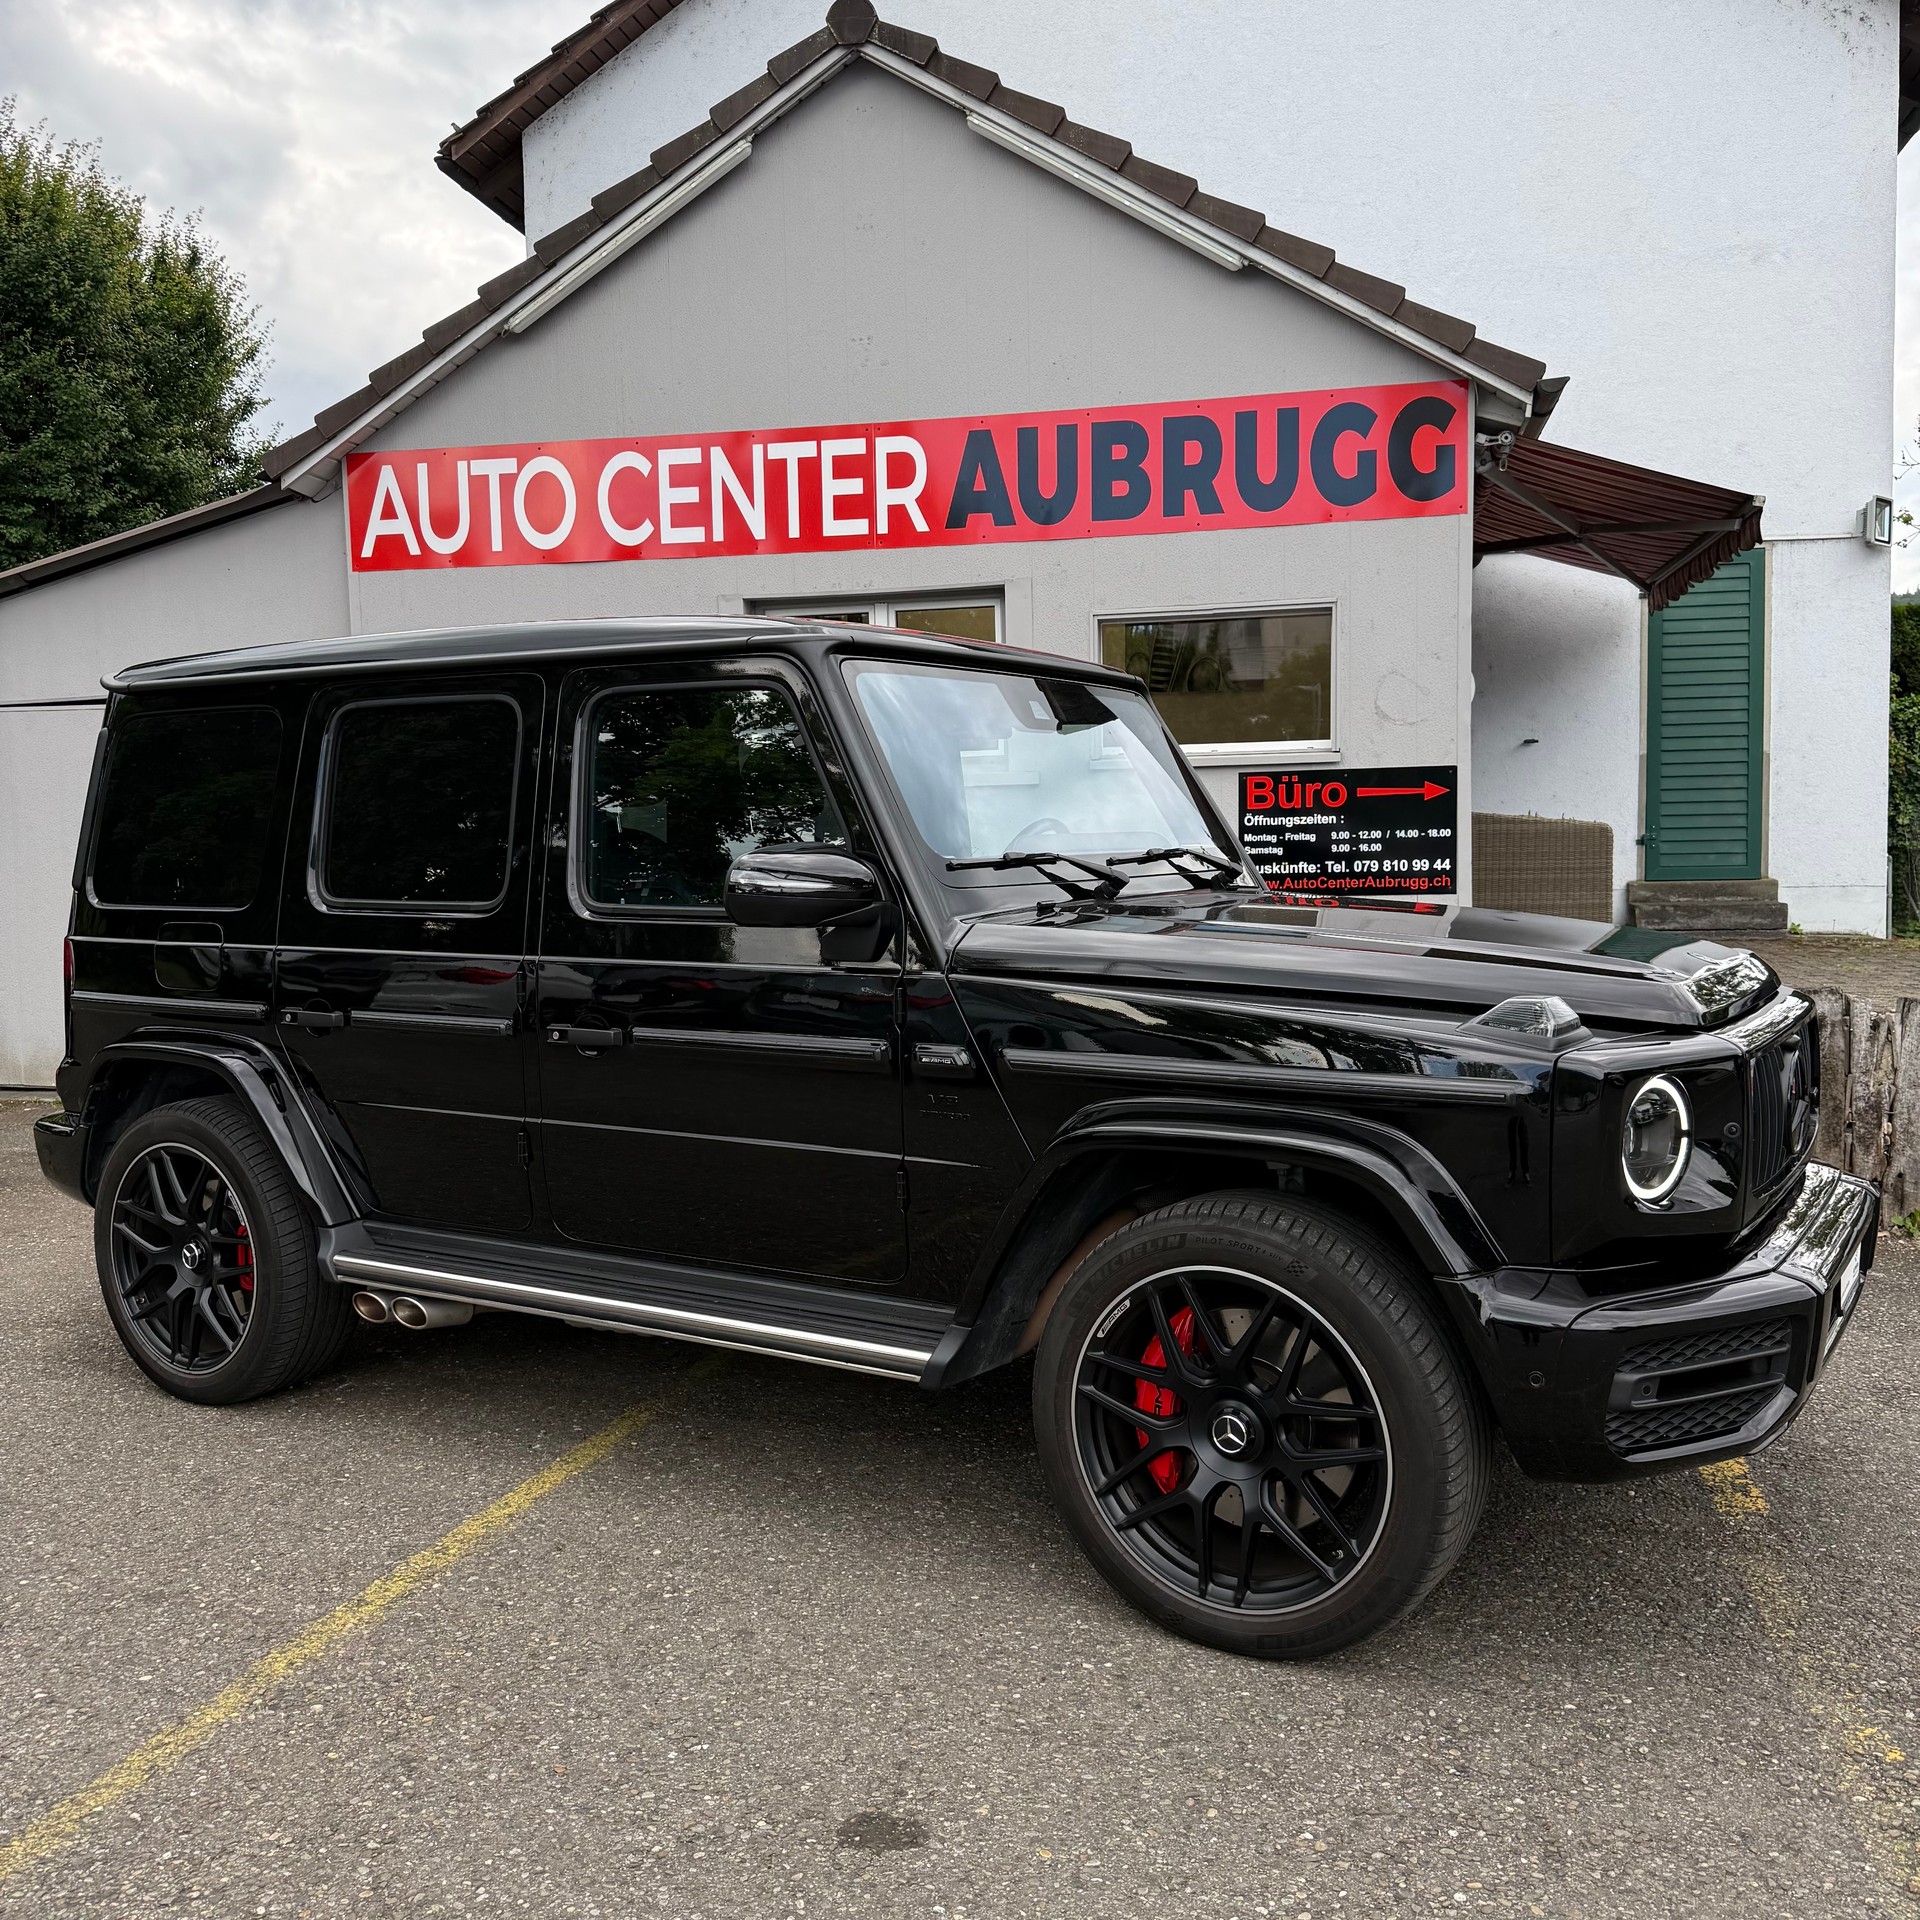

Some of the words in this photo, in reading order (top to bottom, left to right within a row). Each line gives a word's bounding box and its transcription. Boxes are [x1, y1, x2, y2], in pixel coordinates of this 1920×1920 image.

[360, 455, 577, 558] AUTO
[597, 435, 930, 546] CENTER
[944, 396, 1458, 529] AUBRUGG
[1247, 775, 1347, 809] Büro
[1244, 813, 1337, 827] Öffnungszeiten
[1244, 833, 1277, 843] Montag
[1285, 832, 1316, 842] Freitag
[1331, 831, 1350, 840] 9.00
[1358, 830, 1382, 839] 12.00
[1395, 829, 1419, 838] 14.00
[1427, 828, 1452, 838] 18.00
[1244, 846, 1284, 856] Samstag
[1331, 844, 1350, 853] 9.00
[1359, 843, 1383, 852] 16.00
[1255, 862, 1321, 874] uskünfte:
[1325, 861, 1350, 873] Tel.
[1353, 860, 1379, 873] 079
[1382, 859, 1409, 872] 810
[1412, 859, 1430, 872] 99
[1433, 858, 1452, 871] 44
[1195, 1236, 1224, 1245] PILOT
[1226, 1239, 1261, 1254] SPORT
